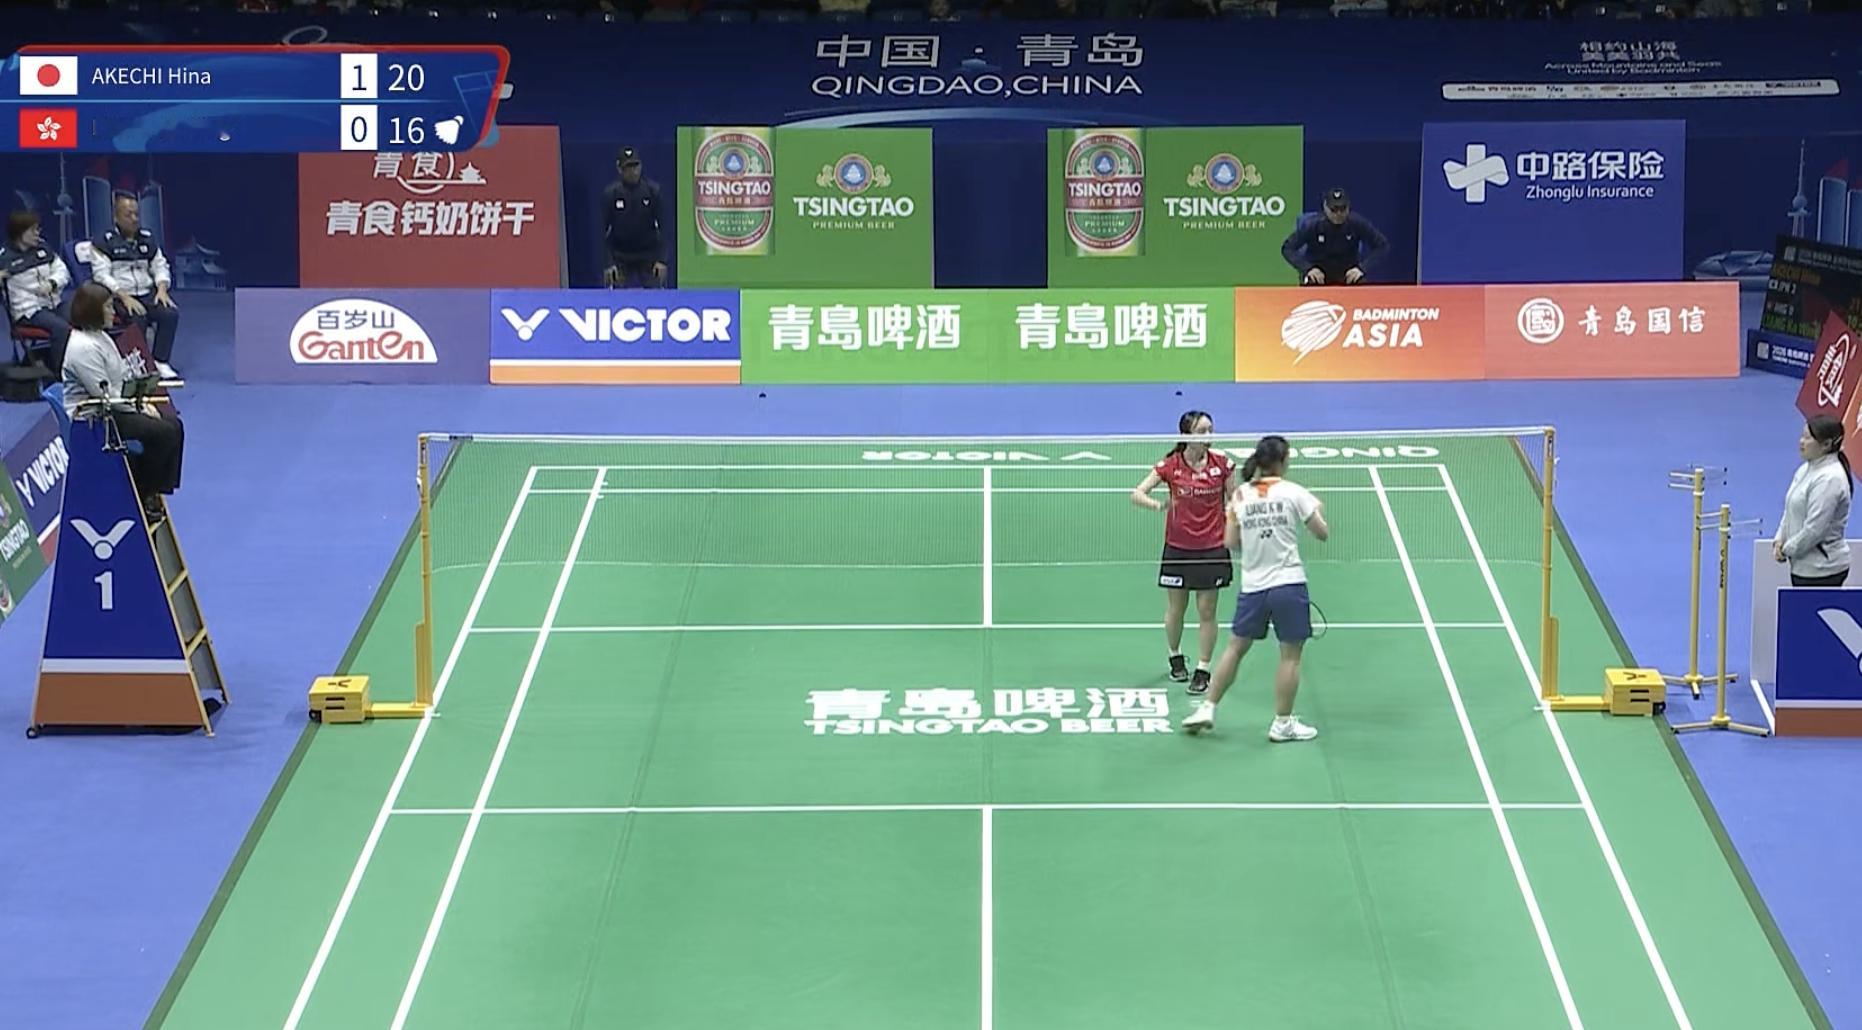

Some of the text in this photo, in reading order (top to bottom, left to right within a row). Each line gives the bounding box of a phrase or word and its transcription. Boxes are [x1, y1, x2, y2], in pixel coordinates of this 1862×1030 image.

[811, 75, 1143, 98] QINGDAO,CHINA
[1517, 151, 1664, 181] 中路保险
[698, 181, 771, 195] TSINGTAO
[1068, 182, 1142, 197] TSINGTAO
[1526, 185, 1654, 202] Zhonglu Insurance
[793, 196, 914, 216] TSINGTAO
[1163, 196, 1285, 217] TSINGTAO
[325, 201, 535, 236] 青食钙奶饼干
[813, 221, 895, 229] PREMIUM BEER
[1183, 221, 1265, 230] PREMIUM BEER
[317, 309, 395, 330] 百岁山
[1352, 307, 1440, 320] BADMINTON
[1578, 304, 1706, 337] 青岛国信
[558, 307, 731, 342] VICTOR
[1342, 322, 1425, 349] ASIA
[27, 435, 69, 494] VICTOR
[94, 571, 113, 610] 1
[804, 718, 1174, 735] TSINGTAO BEER
